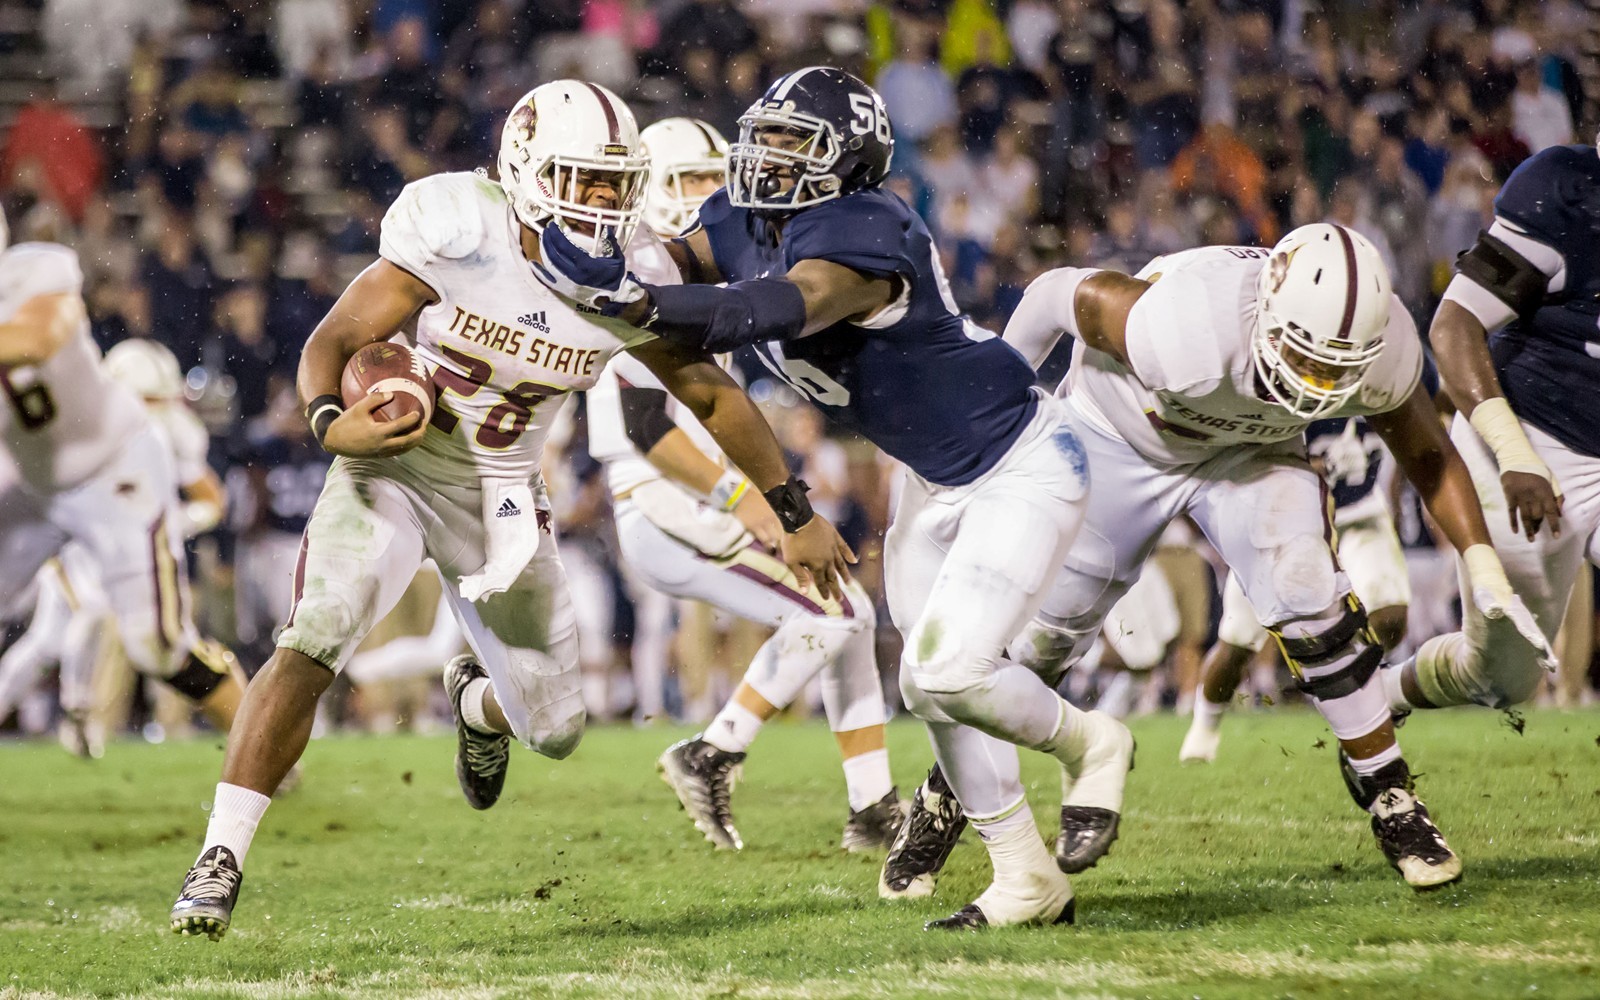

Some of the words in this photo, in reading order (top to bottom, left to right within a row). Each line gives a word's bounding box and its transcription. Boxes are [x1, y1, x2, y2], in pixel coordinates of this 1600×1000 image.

[848, 93, 892, 146] 56
[535, 173, 553, 199] iddel
[449, 305, 525, 356] TEXAS
[526, 338, 600, 375] STATE
[517, 315, 551, 334] adidas
[428, 341, 568, 452] 28
[1169, 398, 1242, 432] TEXAS
[496, 508, 521, 518] adidas
